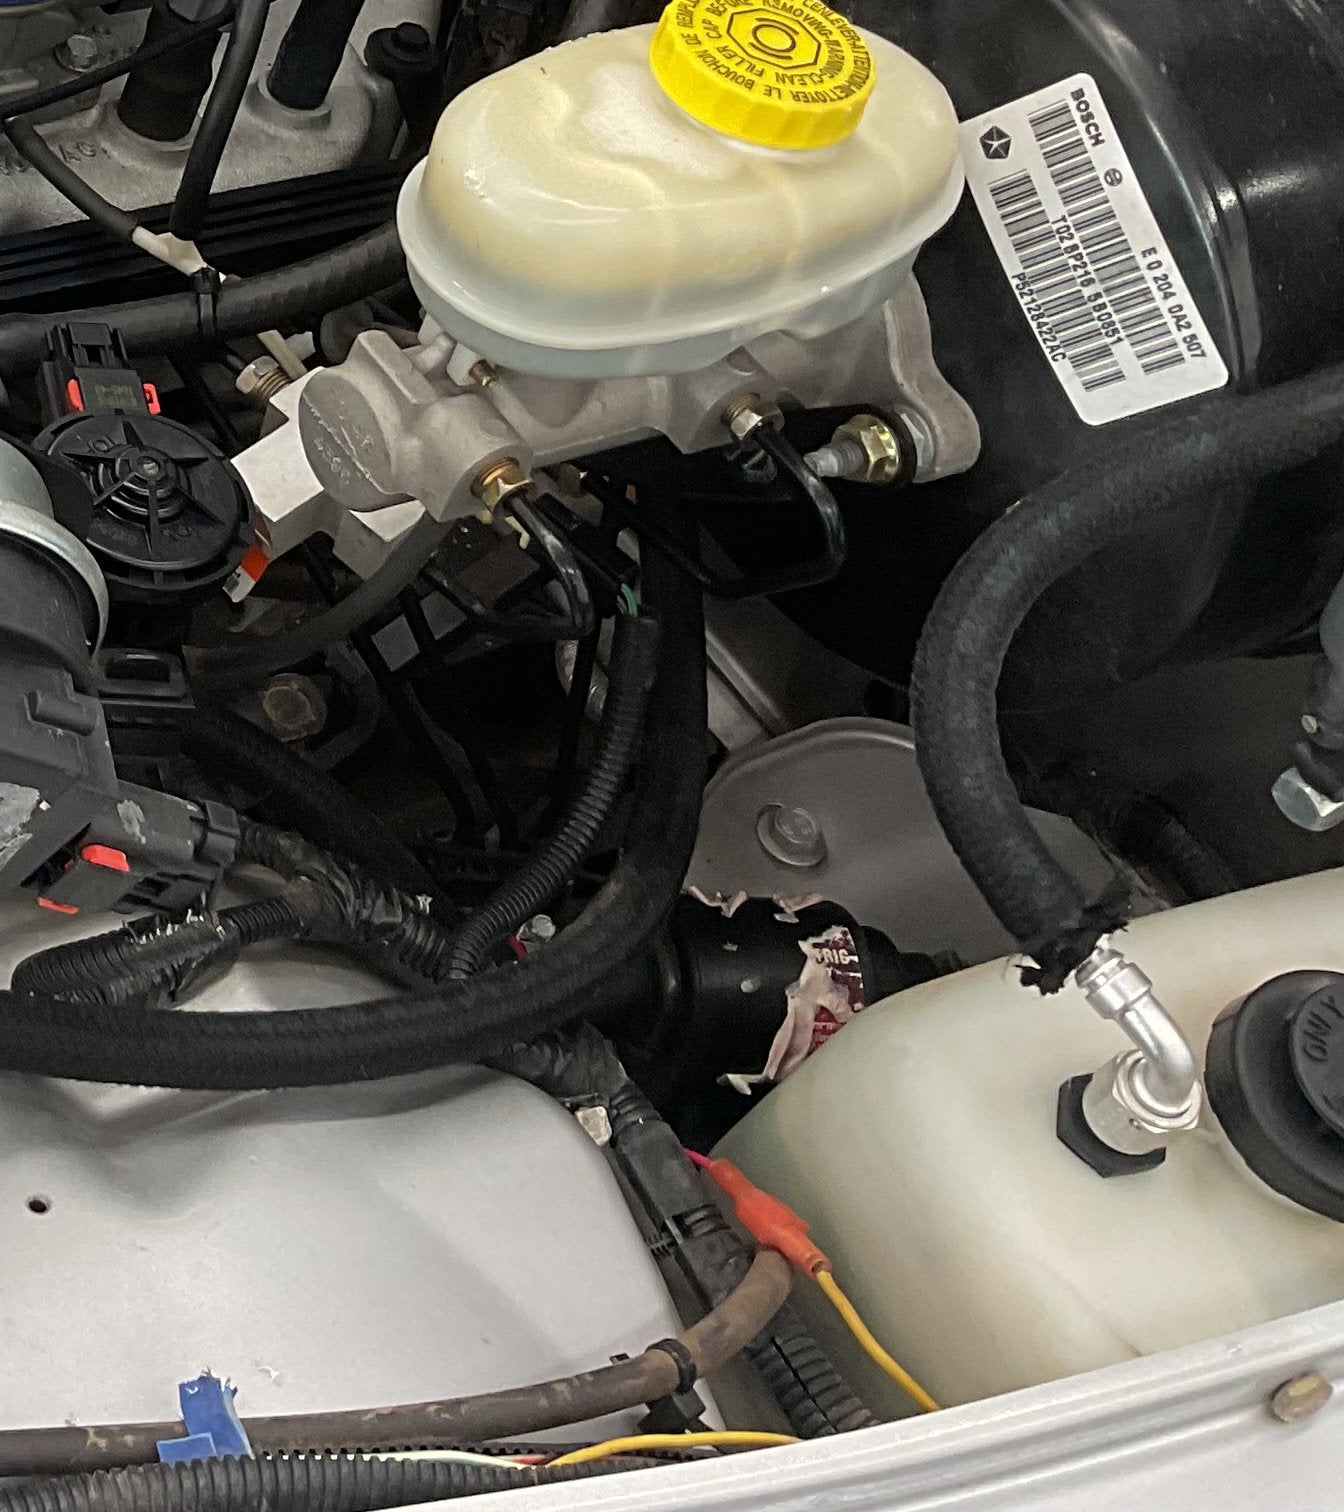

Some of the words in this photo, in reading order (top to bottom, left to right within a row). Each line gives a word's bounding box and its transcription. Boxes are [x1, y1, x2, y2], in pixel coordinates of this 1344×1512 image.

[681, 33, 701, 45] DE
[701, 19, 722, 39] CAP
[696, 49, 756, 90] BOUCHON
[717, 45, 765, 78] FILLER
[763, 86, 782, 100] LE
[1070, 87, 1105, 146] BOSCH
[1141, 247, 1157, 260] E
[1146, 260, 1163, 271] 0
[1153, 273, 1177, 300] 204
[1011, 273, 1067, 363] P52128422AC
[1167, 303, 1192, 333] 0A2
[1182, 333, 1207, 360] 507
